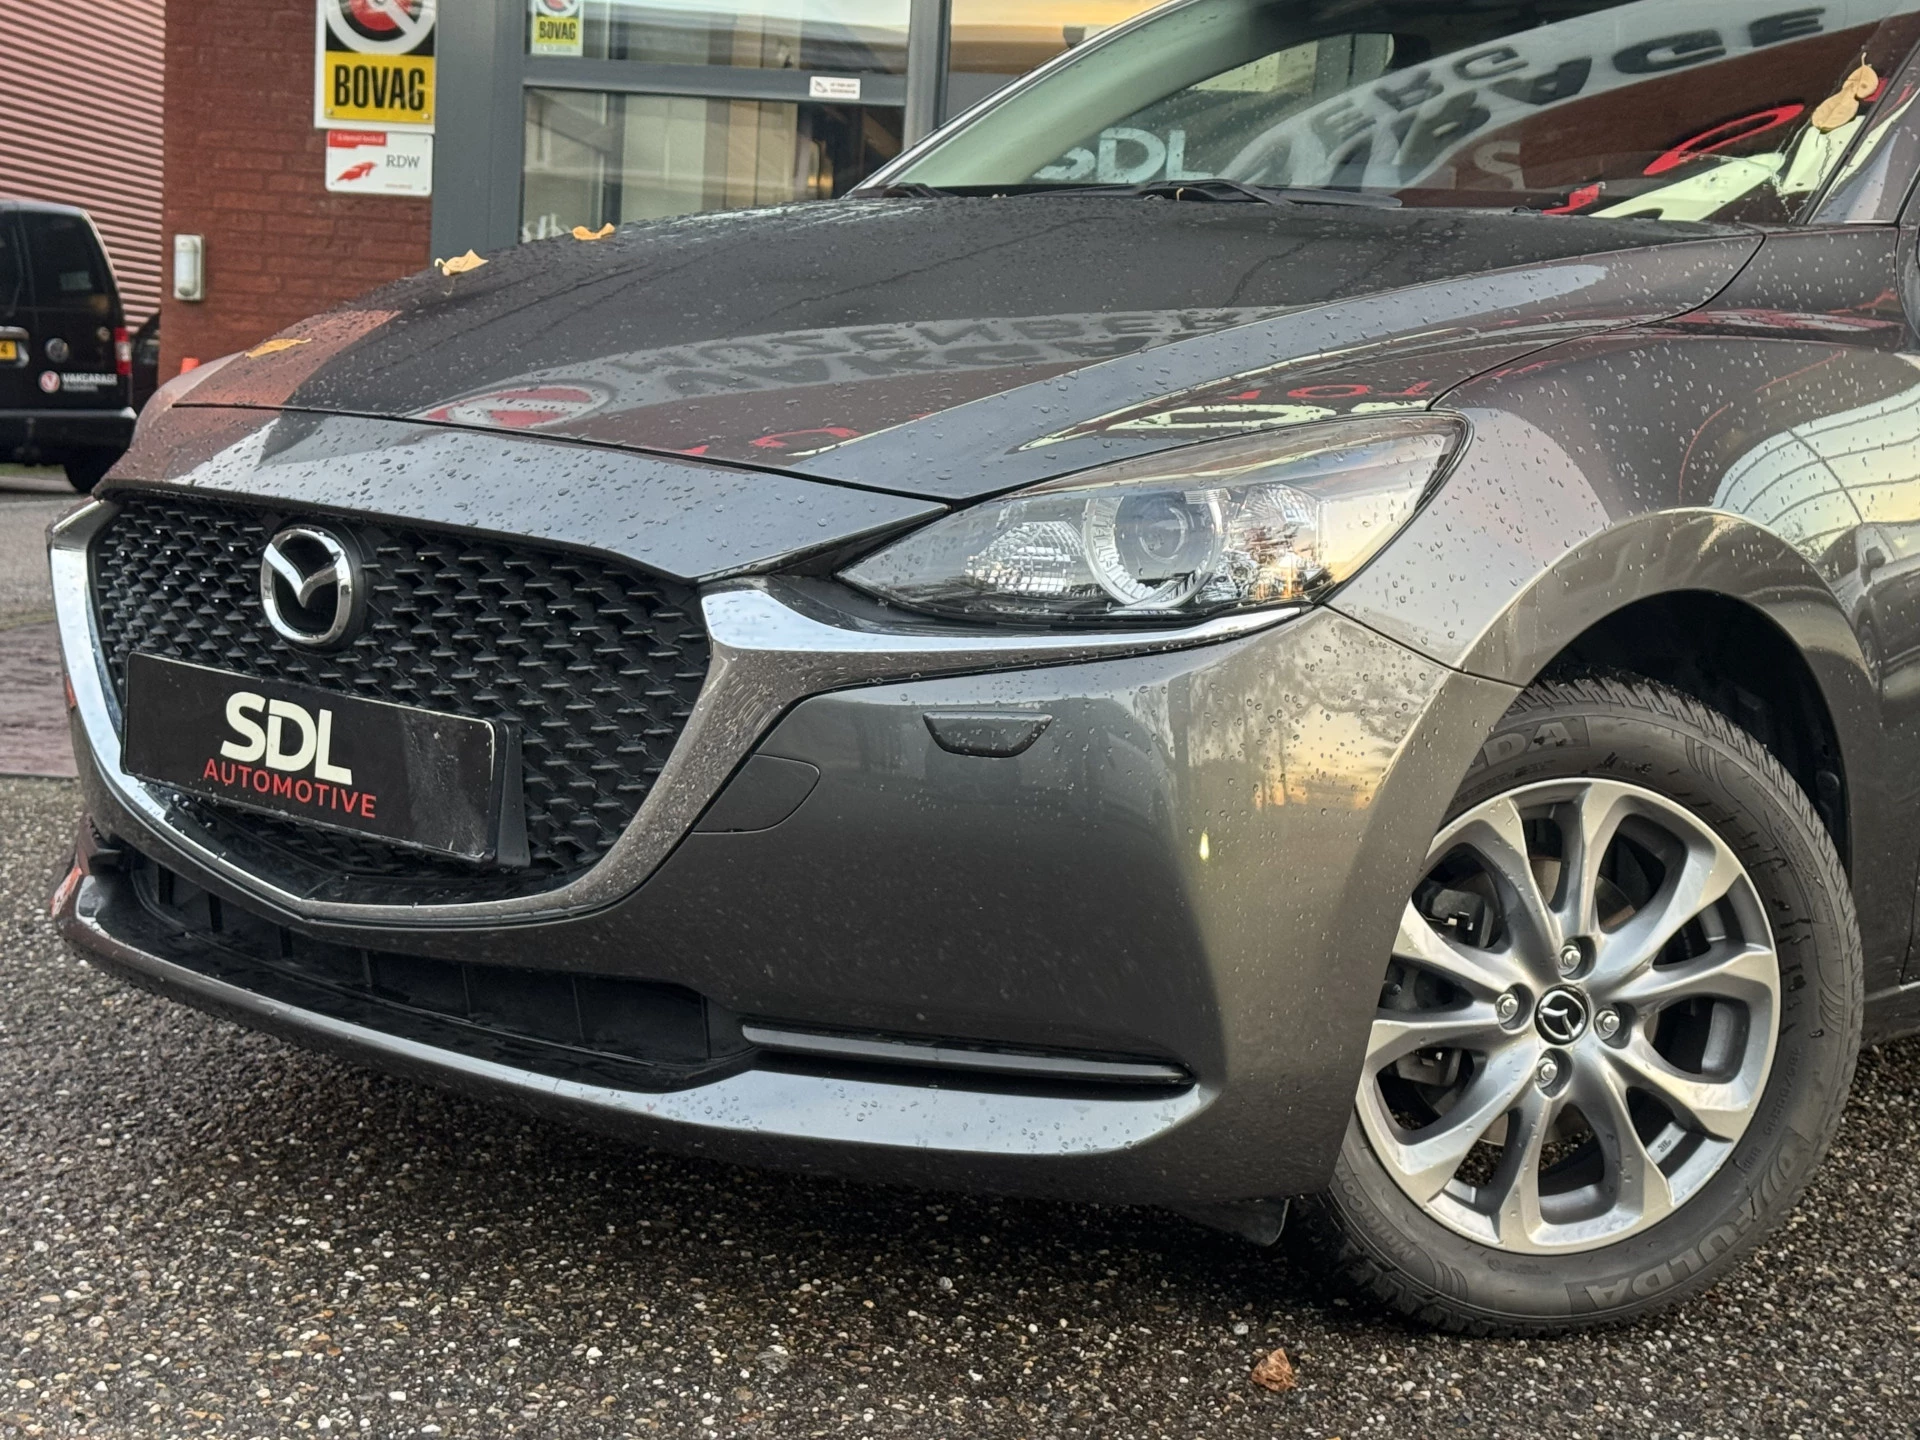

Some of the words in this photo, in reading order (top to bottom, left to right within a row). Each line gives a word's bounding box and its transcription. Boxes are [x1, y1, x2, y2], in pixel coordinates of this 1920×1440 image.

[539, 20, 577, 41] BOVAG
[334, 64, 426, 111] BOVAG
[386, 154, 421, 169] RDW
[220, 691, 353, 786] SDL
[203, 757, 377, 819] AUTOMOTIVE
[1334, 1160, 1417, 1260] MultiCon
[1584, 1199, 1758, 1310] FULDA
